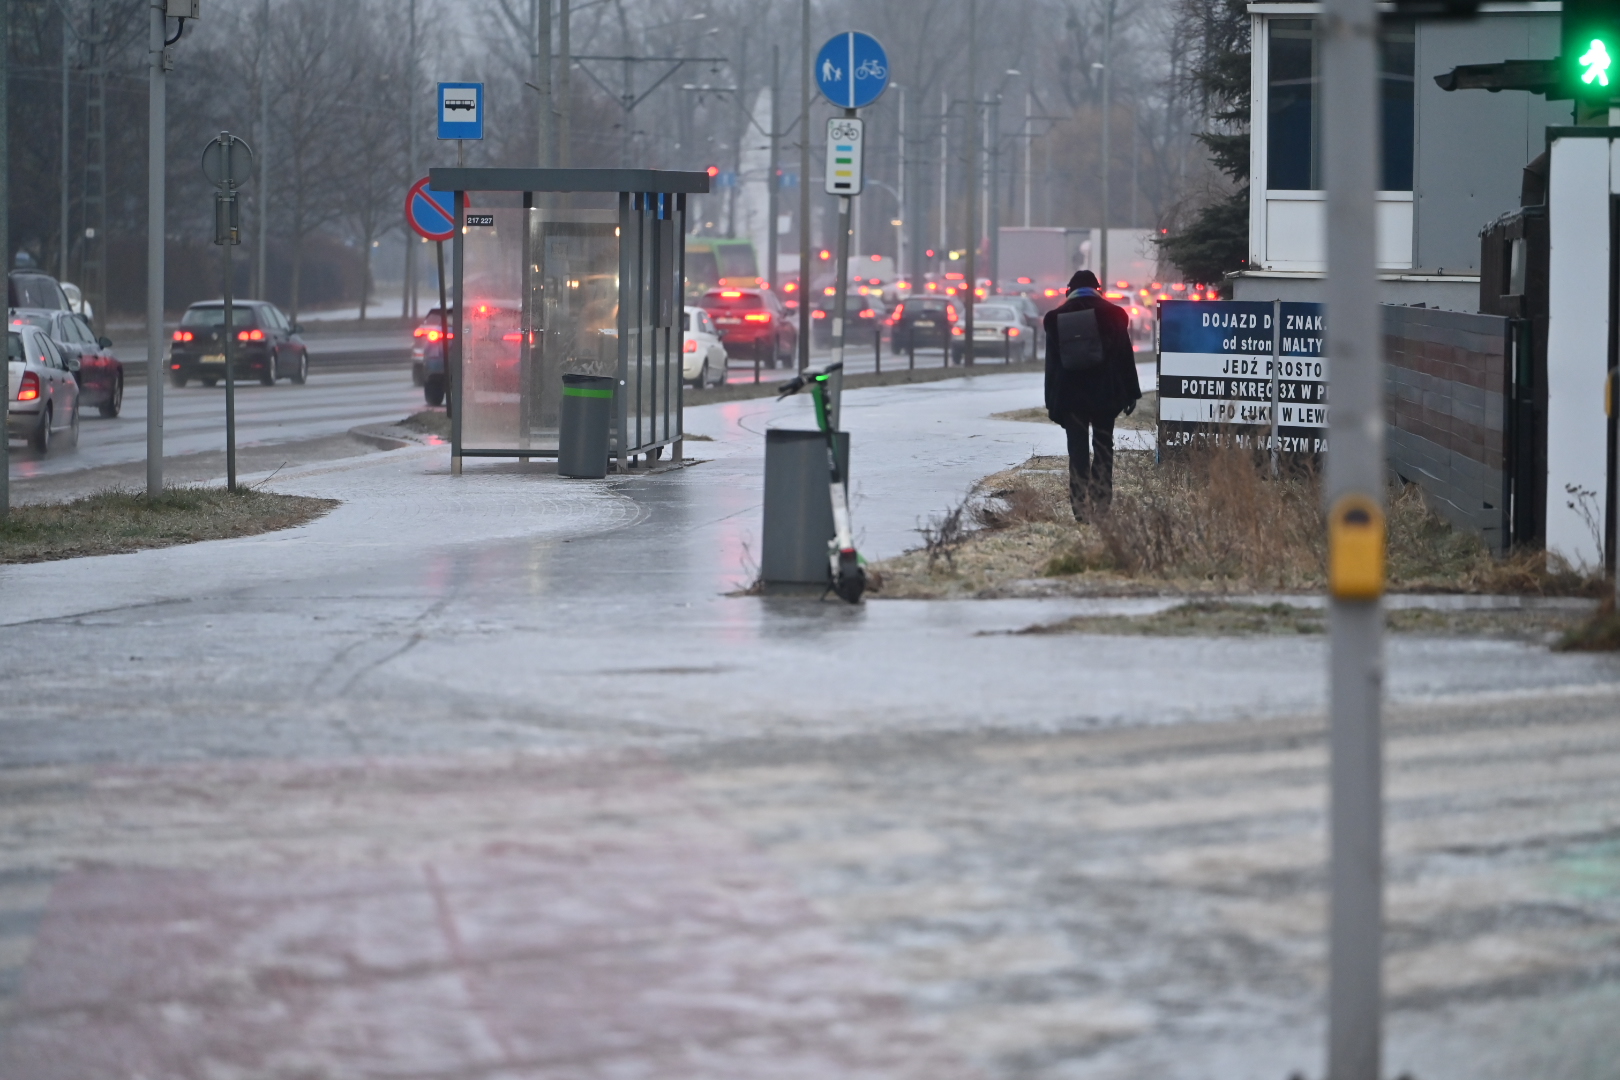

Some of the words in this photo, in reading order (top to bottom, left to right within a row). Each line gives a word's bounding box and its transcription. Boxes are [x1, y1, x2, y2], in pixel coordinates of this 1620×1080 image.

[1202, 312, 1257, 329] DOJAZD
[1263, 314, 1276, 329] D
[1222, 335, 1237, 350] od
[1240, 336, 1274, 351] stron
[1282, 337, 1323, 353] MALTY
[1222, 357, 1258, 375] JEDŹ
[1265, 360, 1322, 378] PROSTO
[1181, 379, 1225, 396] POTEM
[1279, 382, 1296, 399] 3X
[1301, 384, 1312, 400] W
[1219, 404, 1236, 420] PO
[1282, 407, 1293, 422] W
[1298, 407, 1330, 424] LEW
